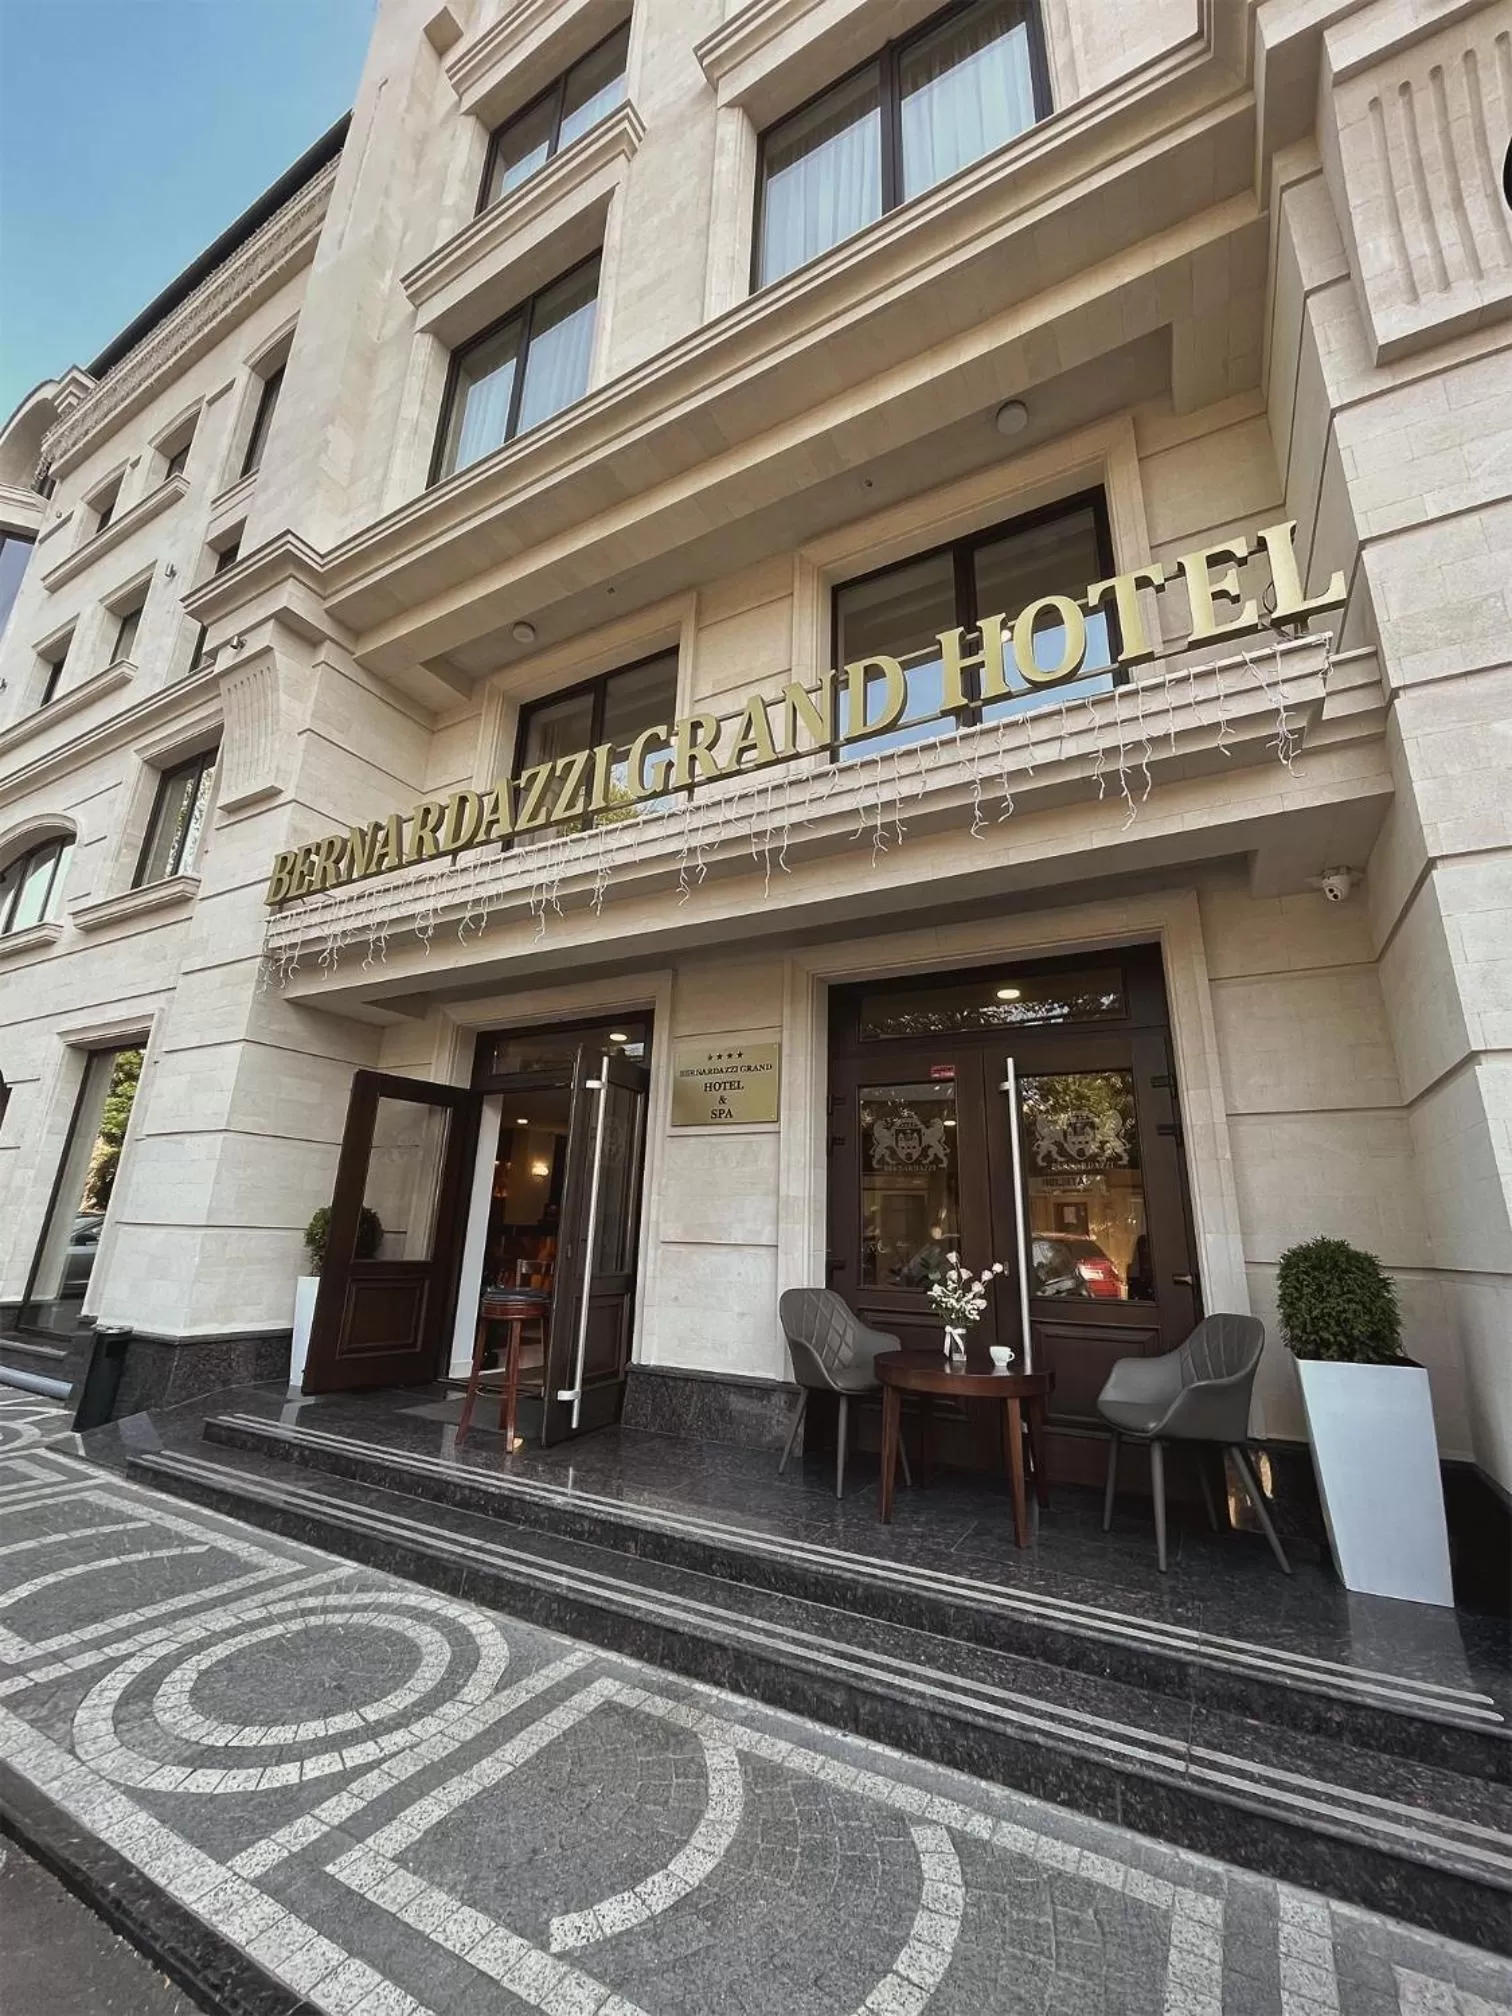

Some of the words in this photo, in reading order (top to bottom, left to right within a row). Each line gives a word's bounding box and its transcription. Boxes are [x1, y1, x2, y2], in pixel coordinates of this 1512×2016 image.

[265, 743, 613, 905] BERNARDAZZI
[626, 655, 909, 800] GRAND
[935, 519, 1347, 716] HOTEL
[680, 1065, 739, 1078] BERNARDAZZI
[740, 1063, 773, 1074] GRAND
[704, 1080, 744, 1092] HOTEL
[718, 1095, 728, 1105] &
[710, 1108, 734, 1119] SPA
